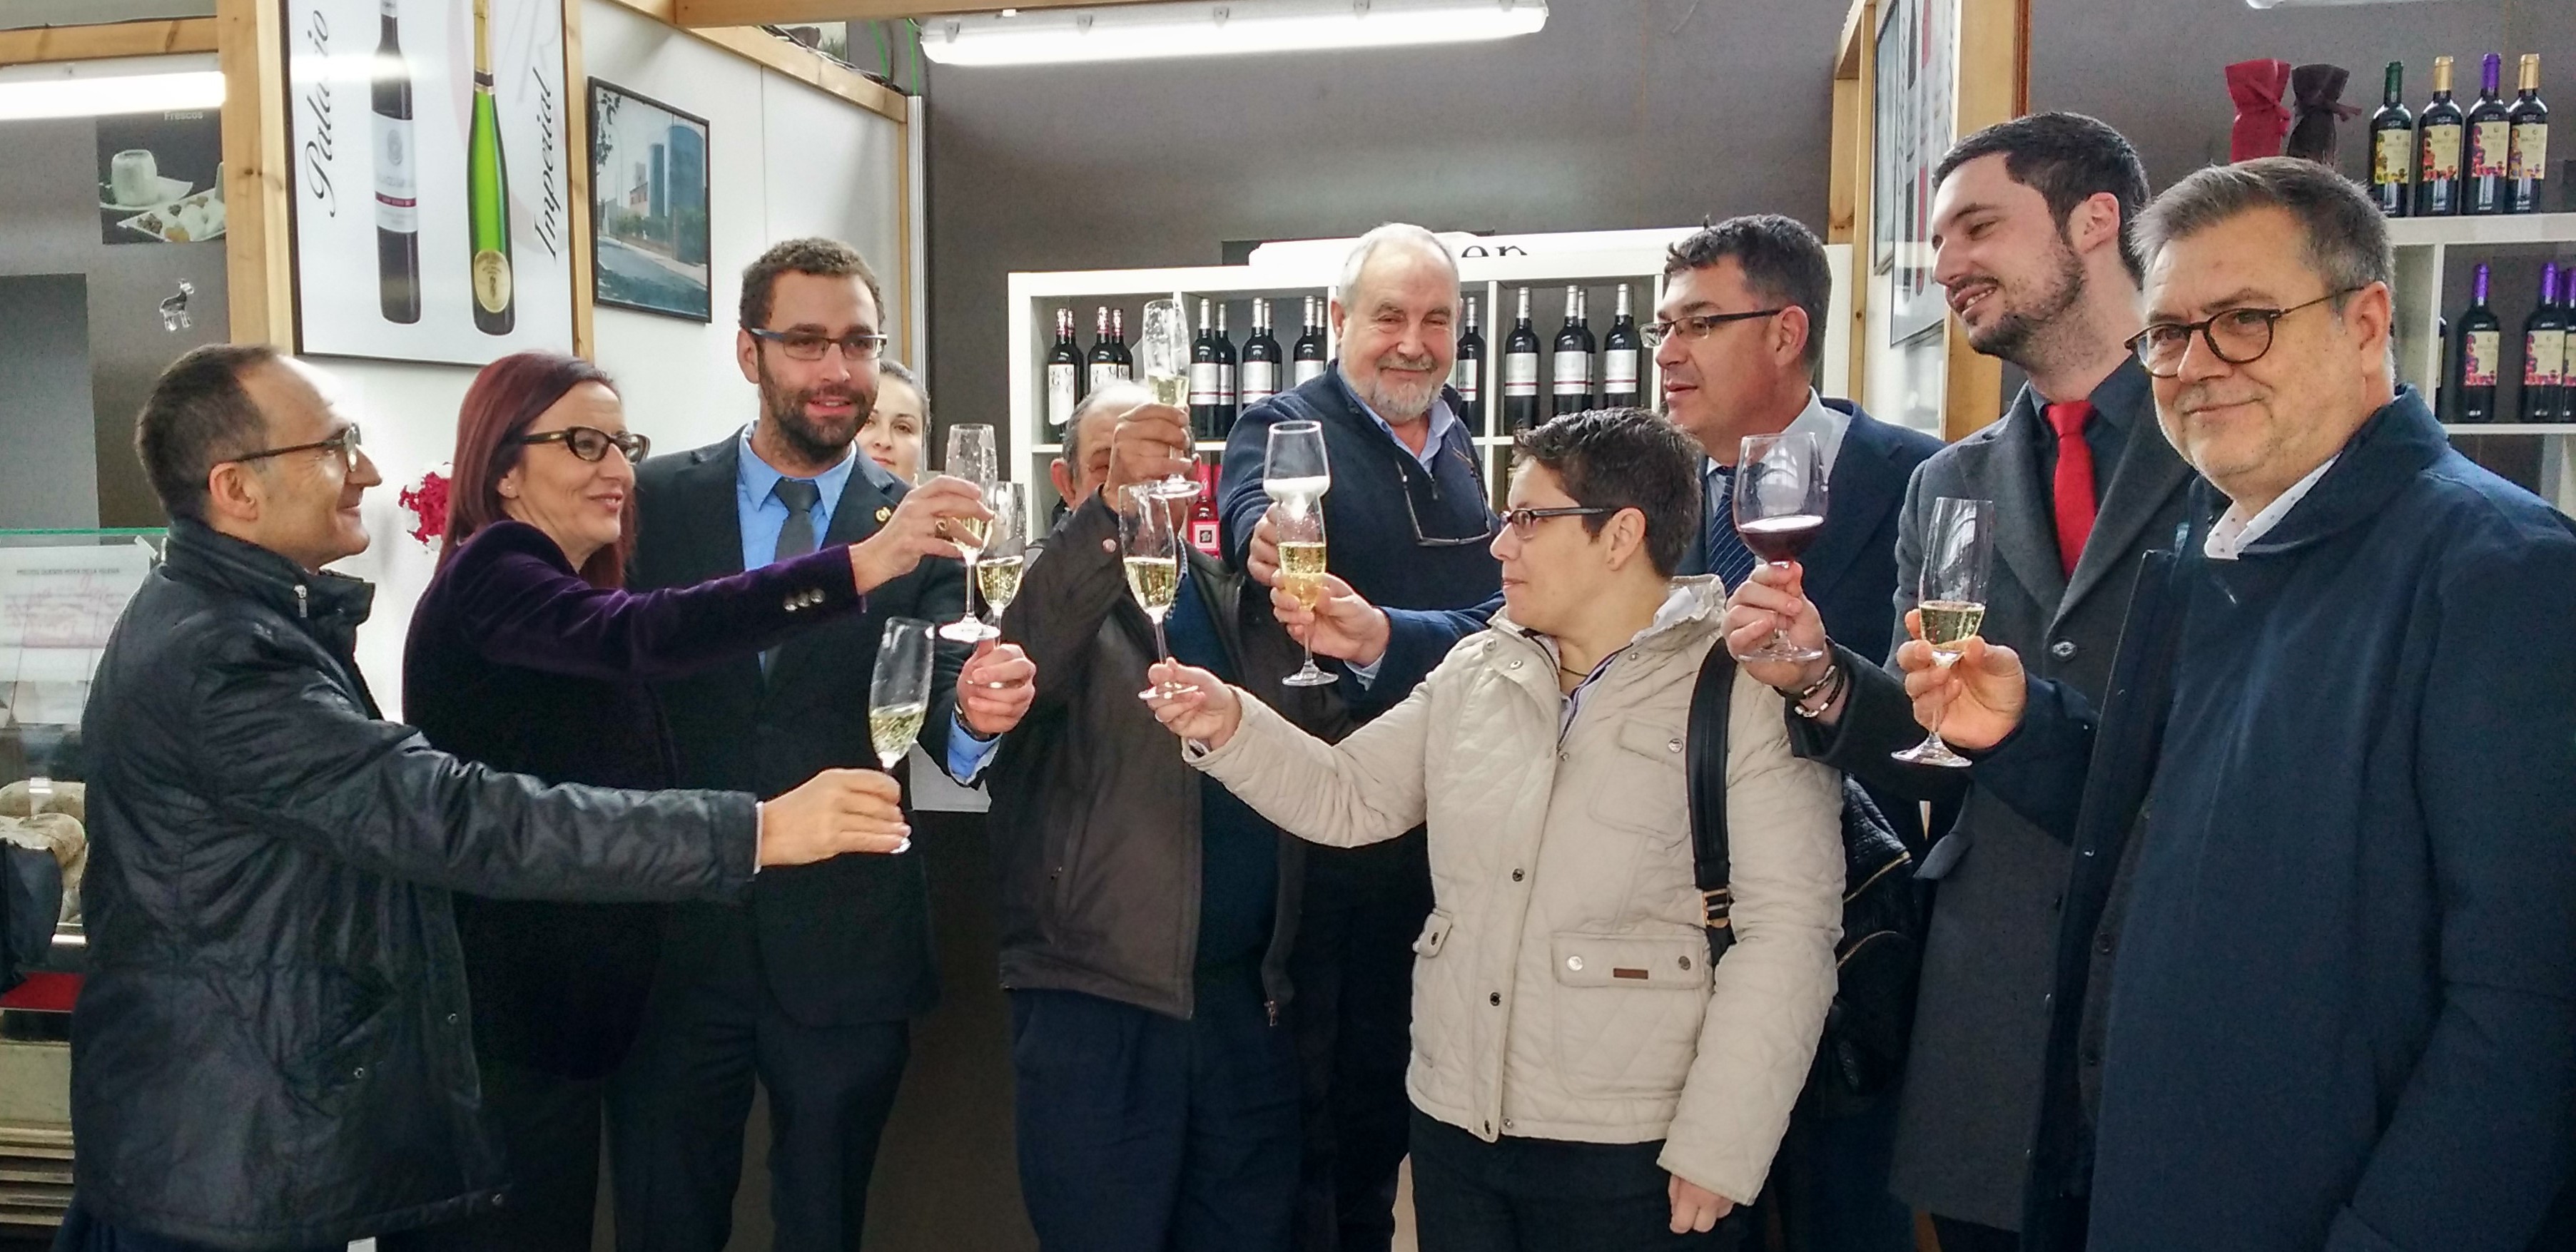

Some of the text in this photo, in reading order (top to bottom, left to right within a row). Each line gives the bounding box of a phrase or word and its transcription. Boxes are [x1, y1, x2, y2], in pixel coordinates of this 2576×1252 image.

[164, 110, 203, 121] Frescos
[305, 10, 335, 218] Palaio
[532, 66, 561, 264] Imperial
